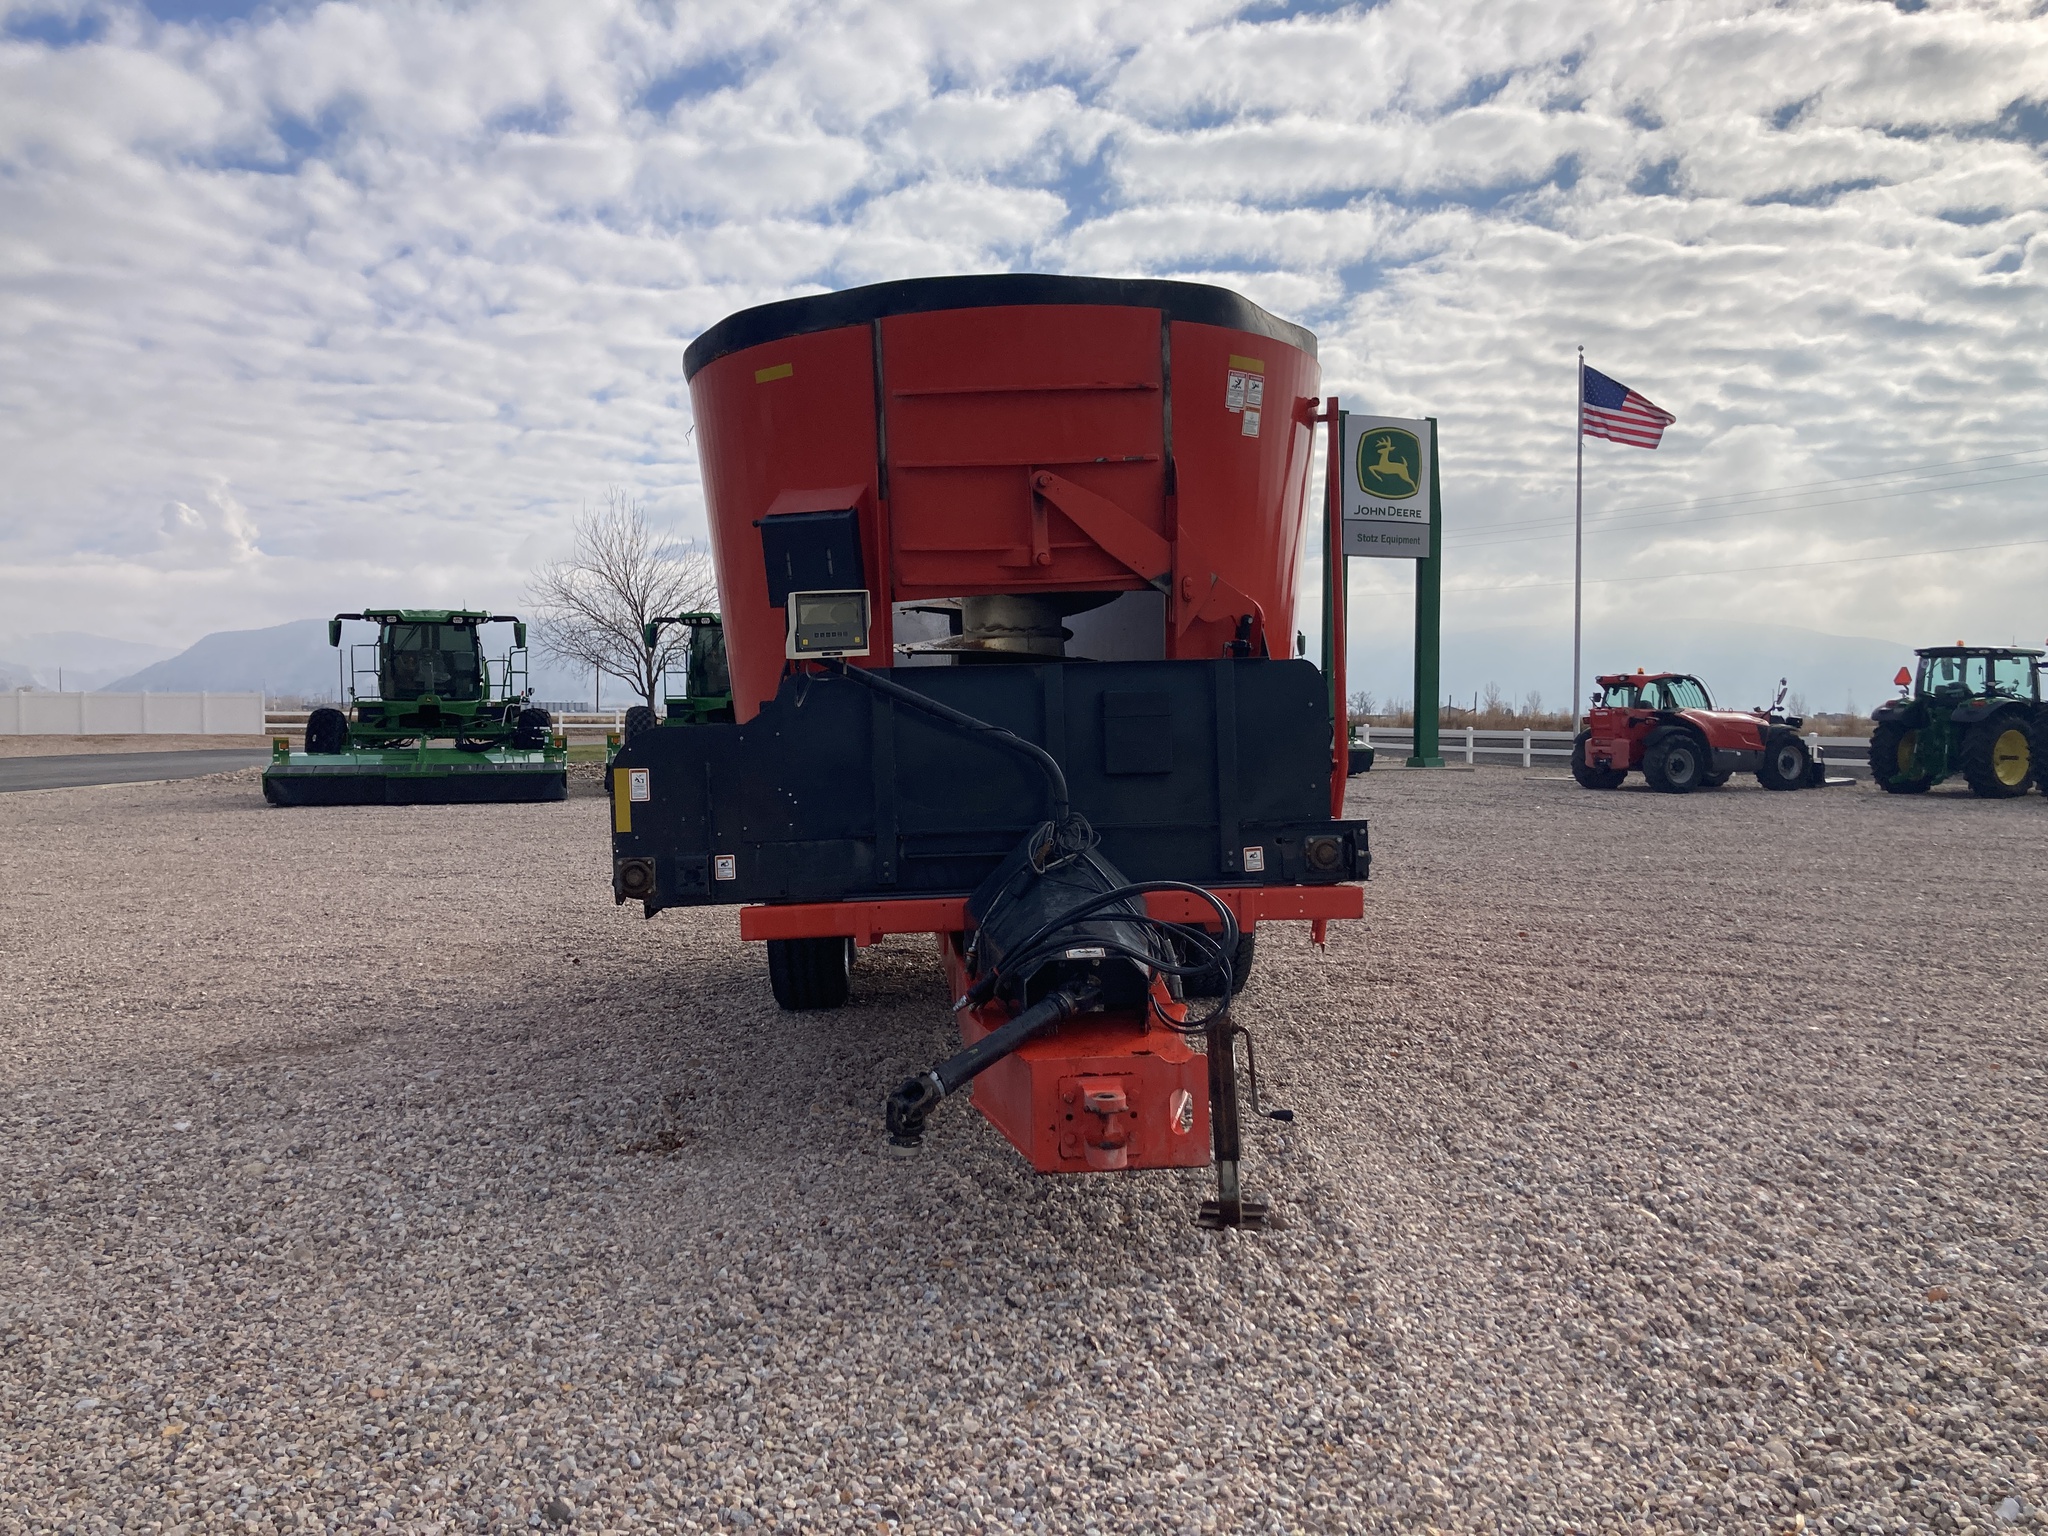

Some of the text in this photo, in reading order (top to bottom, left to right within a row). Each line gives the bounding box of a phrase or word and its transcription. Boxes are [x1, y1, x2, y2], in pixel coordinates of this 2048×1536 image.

[1353, 505, 1422, 518] JOHN DEERE
[1357, 533, 1421, 546] Stotz Equipment
